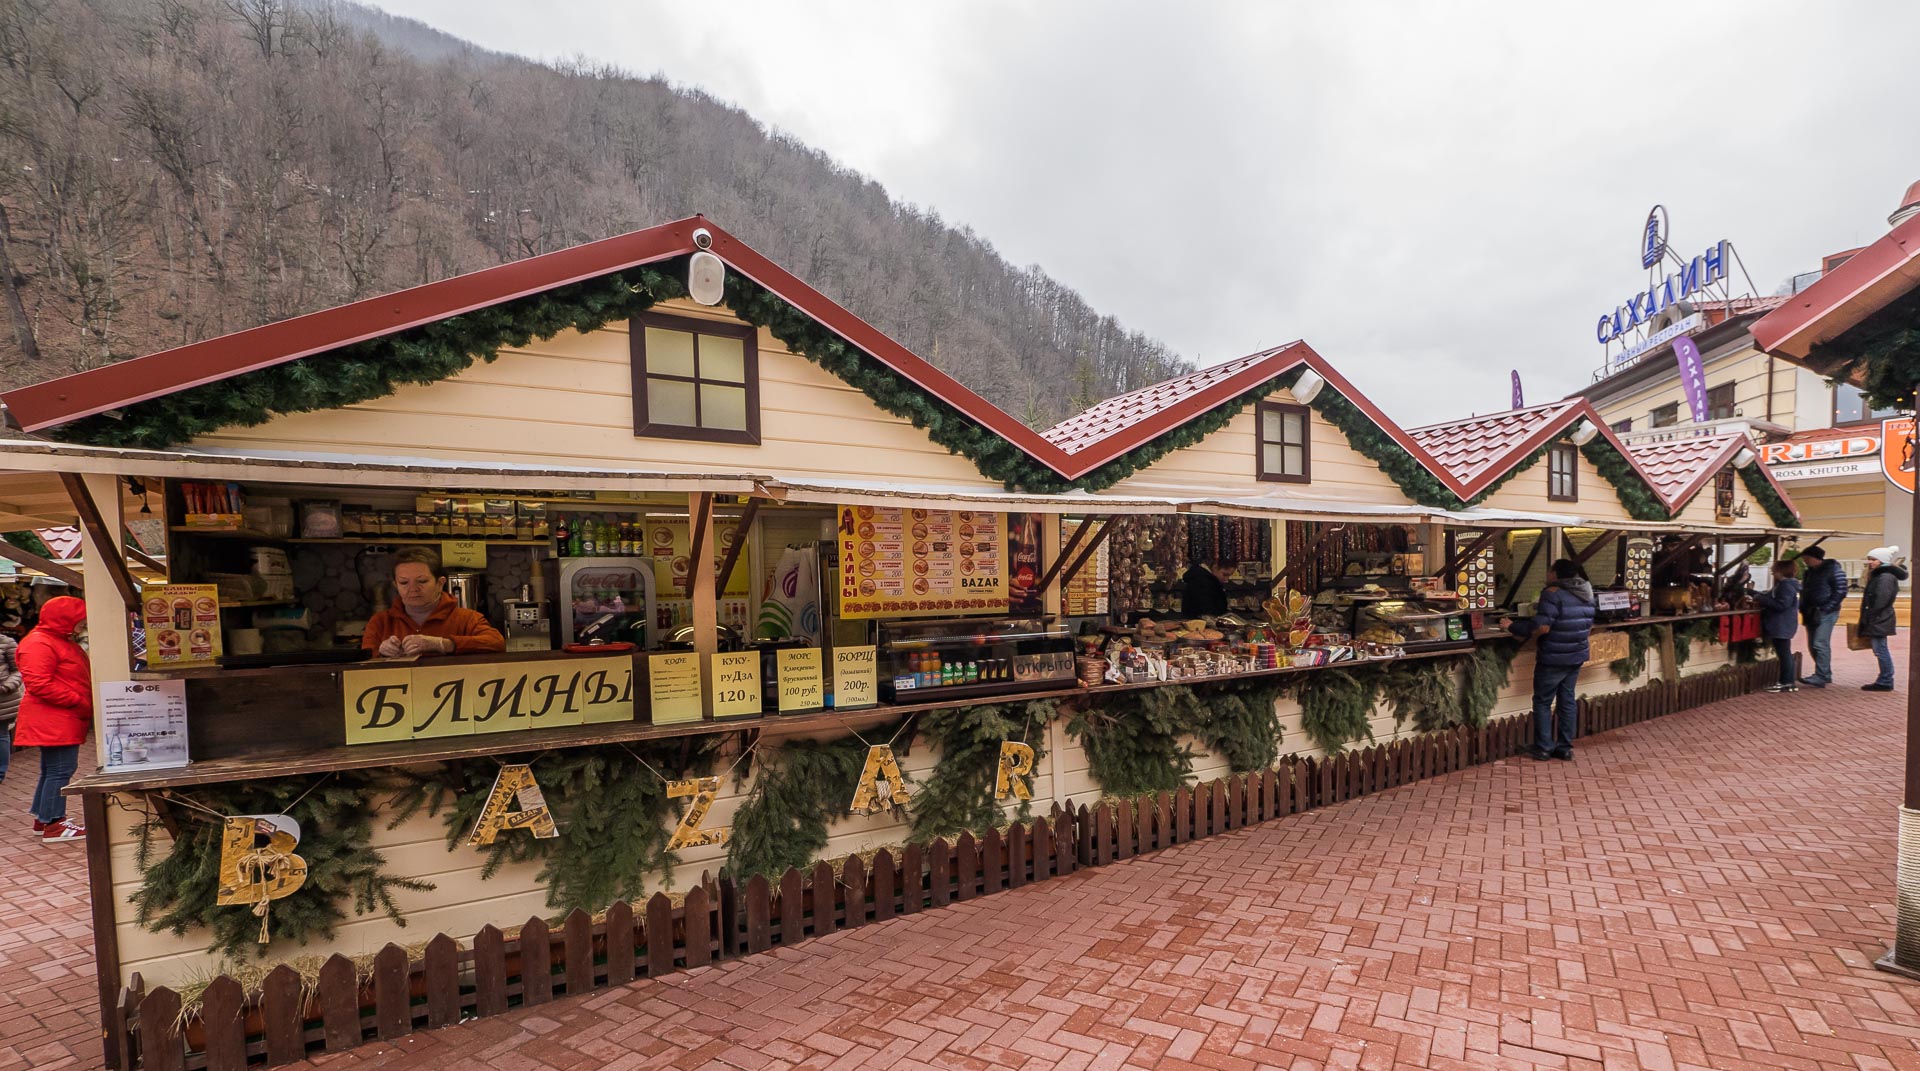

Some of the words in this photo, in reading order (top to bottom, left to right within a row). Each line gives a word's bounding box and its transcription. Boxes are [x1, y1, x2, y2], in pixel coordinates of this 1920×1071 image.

[1597, 239, 1728, 344] САХАЛИН
[1757, 436, 1878, 464] RED
[1775, 469, 1803, 478] ROSA
[1809, 464, 1859, 475] KHUTOR
[843, 541, 858, 597] БЛИНЫ
[961, 578, 999, 587] BAZAR
[664, 657, 687, 665] КОФЕ
[722, 656, 750, 666] КУКУ-
[788, 653, 811, 661] МОРС
[837, 650, 875, 663] БОРЩ
[1016, 659, 1072, 675] ОТКРЫТО
[784, 687, 800, 696] 100
[801, 684, 818, 697] руб.
[843, 680, 870, 692] 200р.
[356, 670, 632, 732] БЛИНЫ
[718, 690, 746, 703] 120
[749, 694, 758, 702] р.
